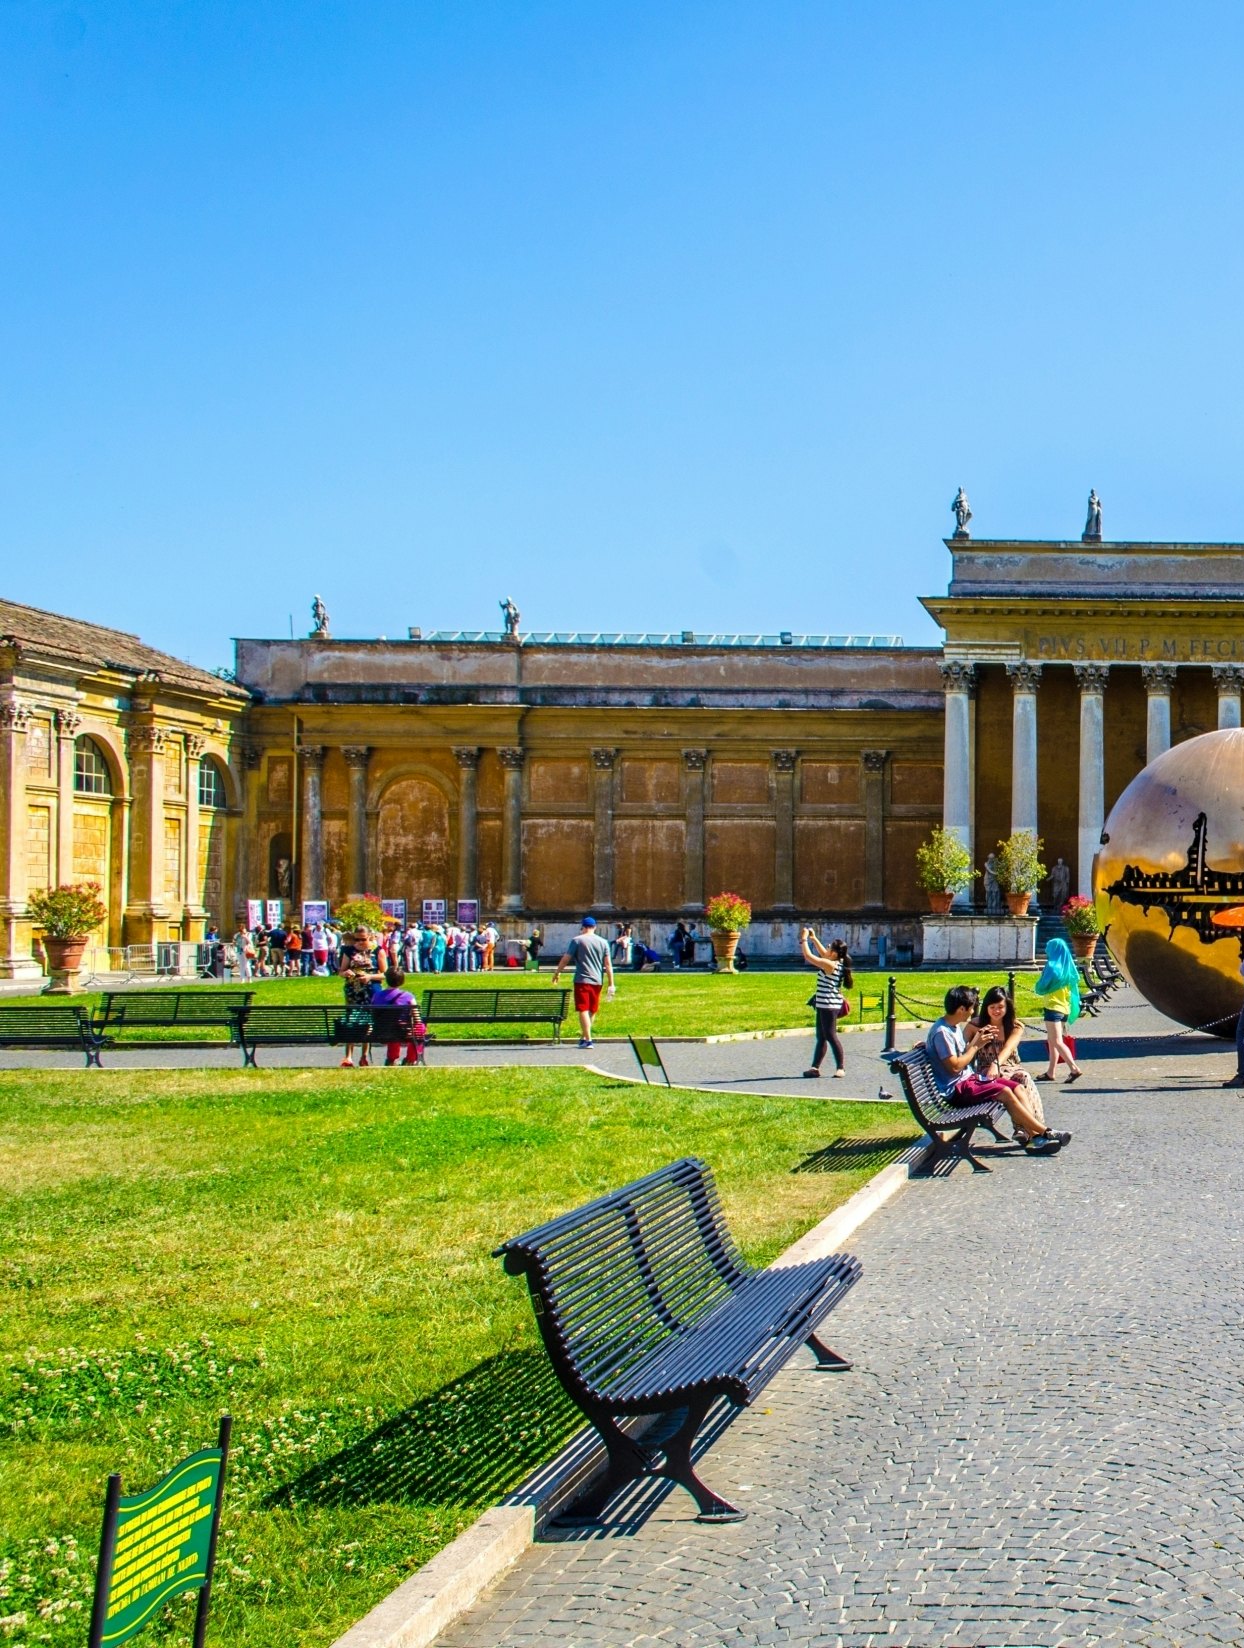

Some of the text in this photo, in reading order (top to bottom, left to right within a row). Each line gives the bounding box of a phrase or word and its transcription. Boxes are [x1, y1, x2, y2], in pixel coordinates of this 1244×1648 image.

[1039, 637, 1085, 654] PIVS
[1099, 638, 1127, 655] VII
[1139, 638, 1150, 655] P
[1162, 639, 1177, 656] M
